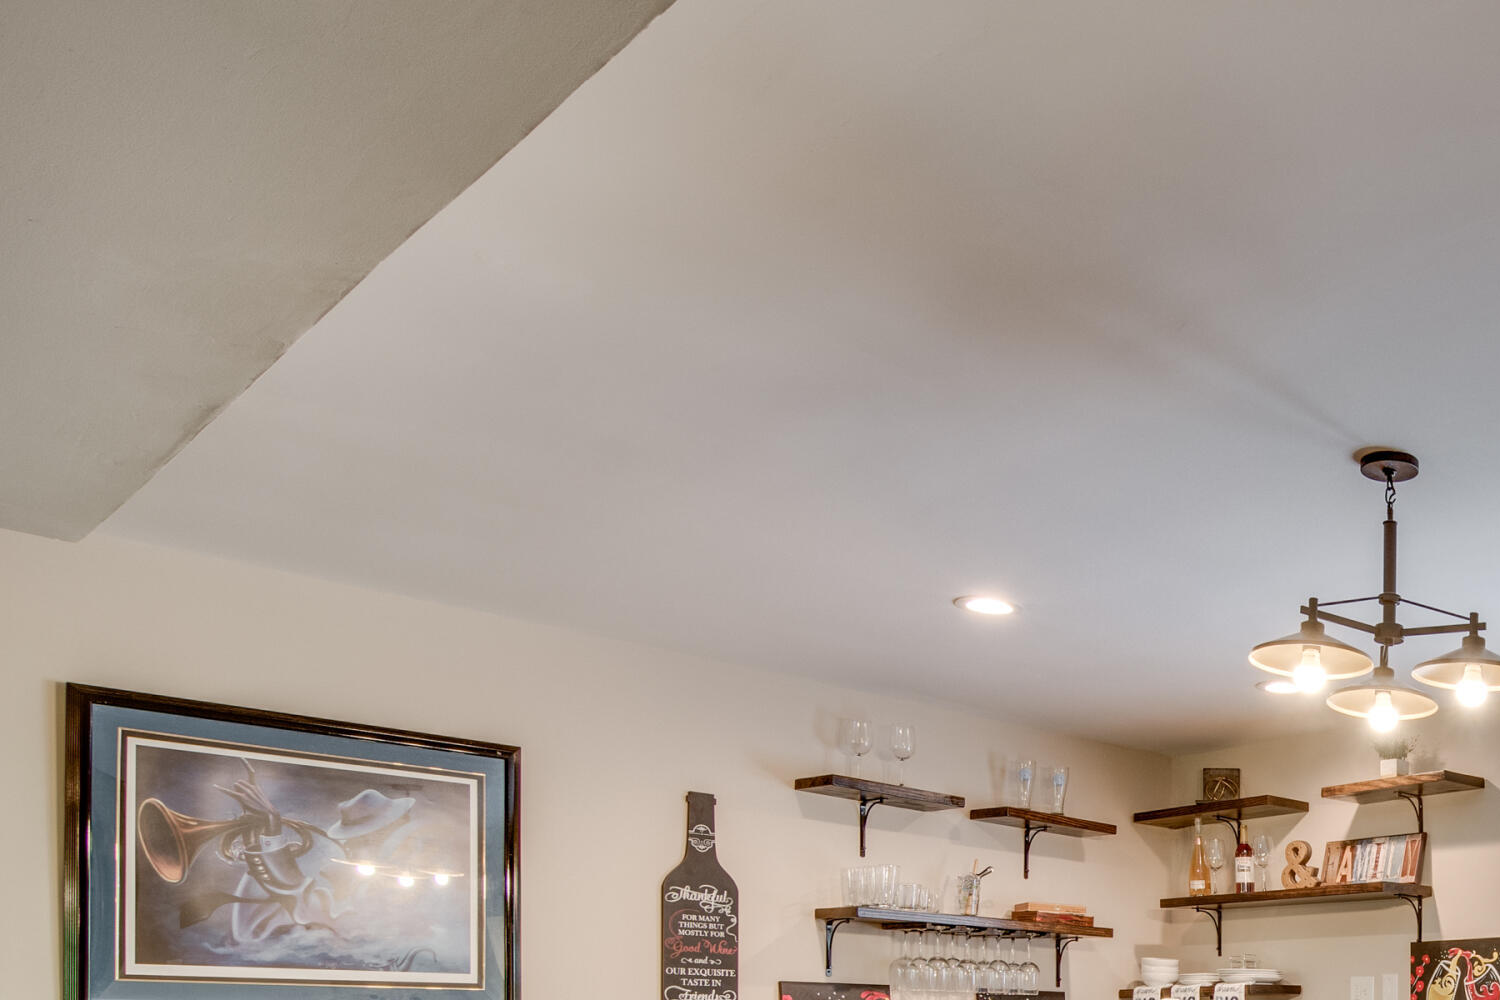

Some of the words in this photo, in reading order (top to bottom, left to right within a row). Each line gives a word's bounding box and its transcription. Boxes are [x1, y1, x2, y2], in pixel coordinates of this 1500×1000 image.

[1281, 840, 1322, 889] &
[665, 884, 734, 913] Thankful
[678, 921, 708, 929] THINGS
[678, 929, 709, 937] MOSTLY
[664, 936, 702, 958] Good
[702, 938, 737, 955] Wine
[694, 956, 709, 965] and
[665, 967, 686, 975] OUR
[687, 968, 736, 977] EXQUISITE
[680, 978, 710, 987] TASTE
[711, 979, 722, 987] IN
